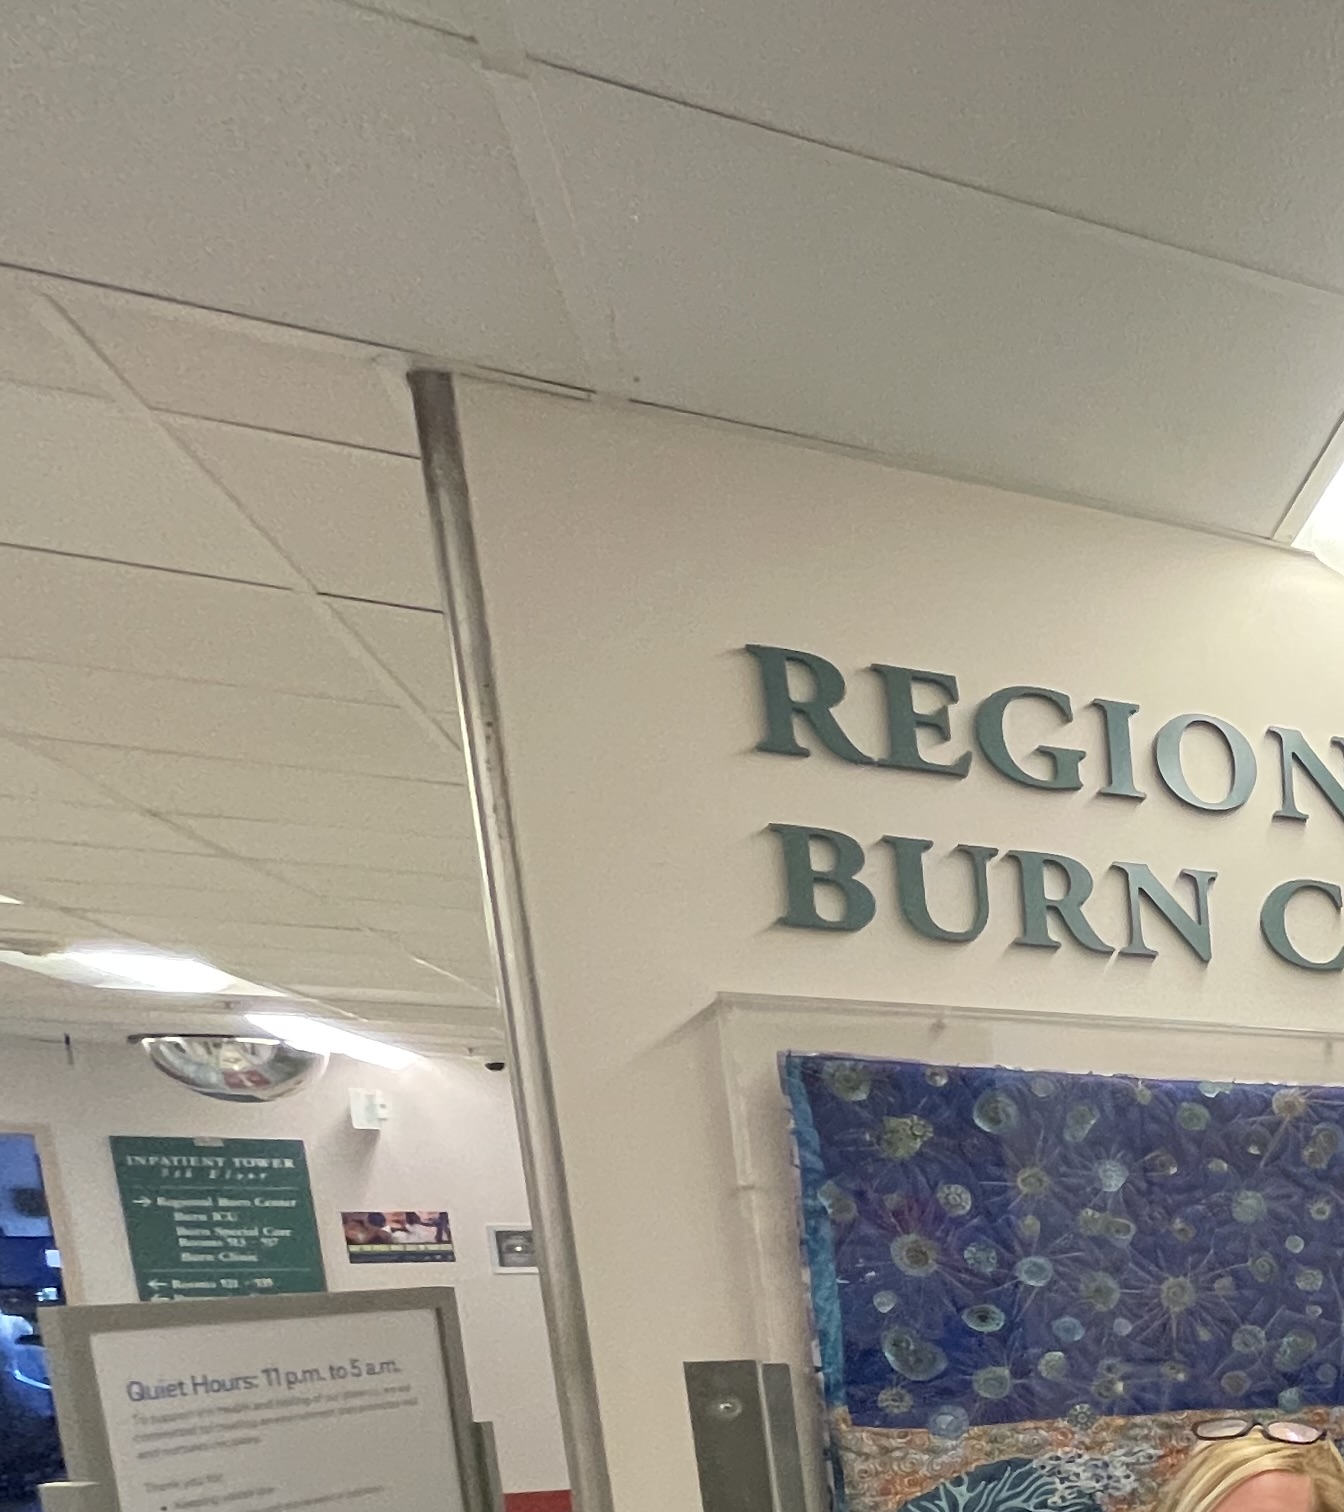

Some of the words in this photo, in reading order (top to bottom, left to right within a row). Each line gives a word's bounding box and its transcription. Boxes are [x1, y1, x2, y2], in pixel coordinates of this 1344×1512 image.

[768, 822, 1219, 964] BURN
[125, 1155, 226, 1167] INPATIENT
[231, 1157, 295, 1168] TOWER
[253, 1197, 296, 1207] Center
[126, 1379, 187, 1402] Quiet
[192, 1374, 258, 1395] Hours:
[261, 1367, 281, 1387] 11
[286, 1367, 326, 1391] p.m.
[328, 1364, 348, 1380] to
[350, 1358, 362, 1378] 5
[365, 1359, 402, 1376] a.m.
